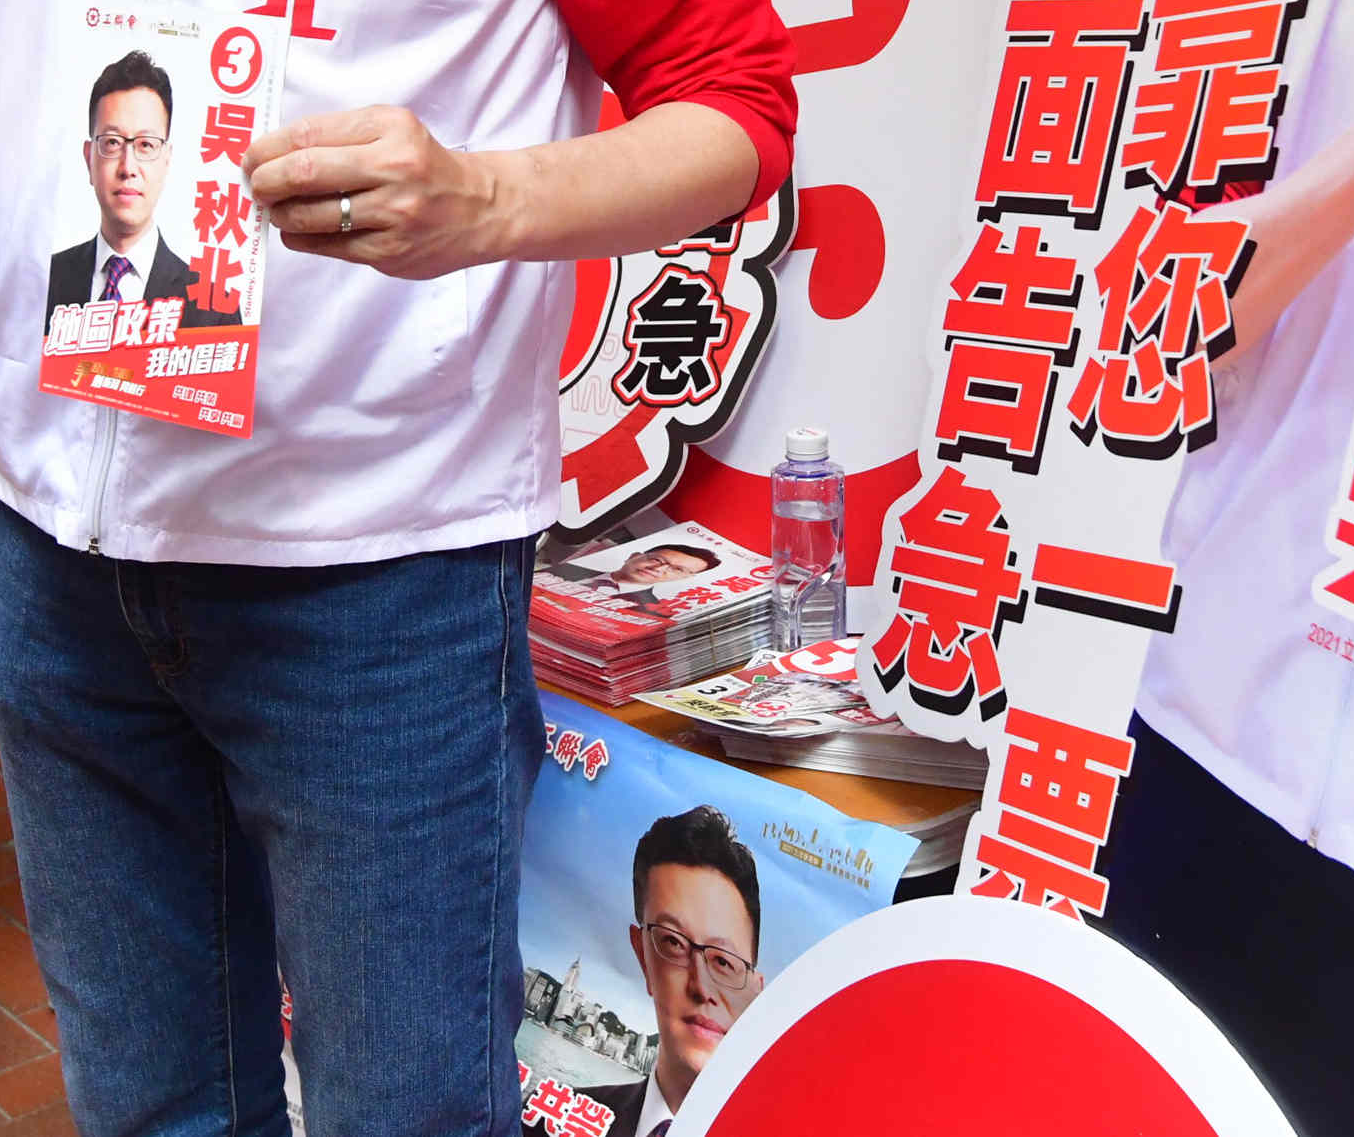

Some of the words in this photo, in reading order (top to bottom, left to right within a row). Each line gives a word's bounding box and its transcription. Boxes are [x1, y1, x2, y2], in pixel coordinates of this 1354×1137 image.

[218, 37, 256, 87] 3
[186, 102, 256, 317] 吳秋北
[45, 299, 184, 356] 地區政策
[145, 338, 251, 379] 我的倡議!
